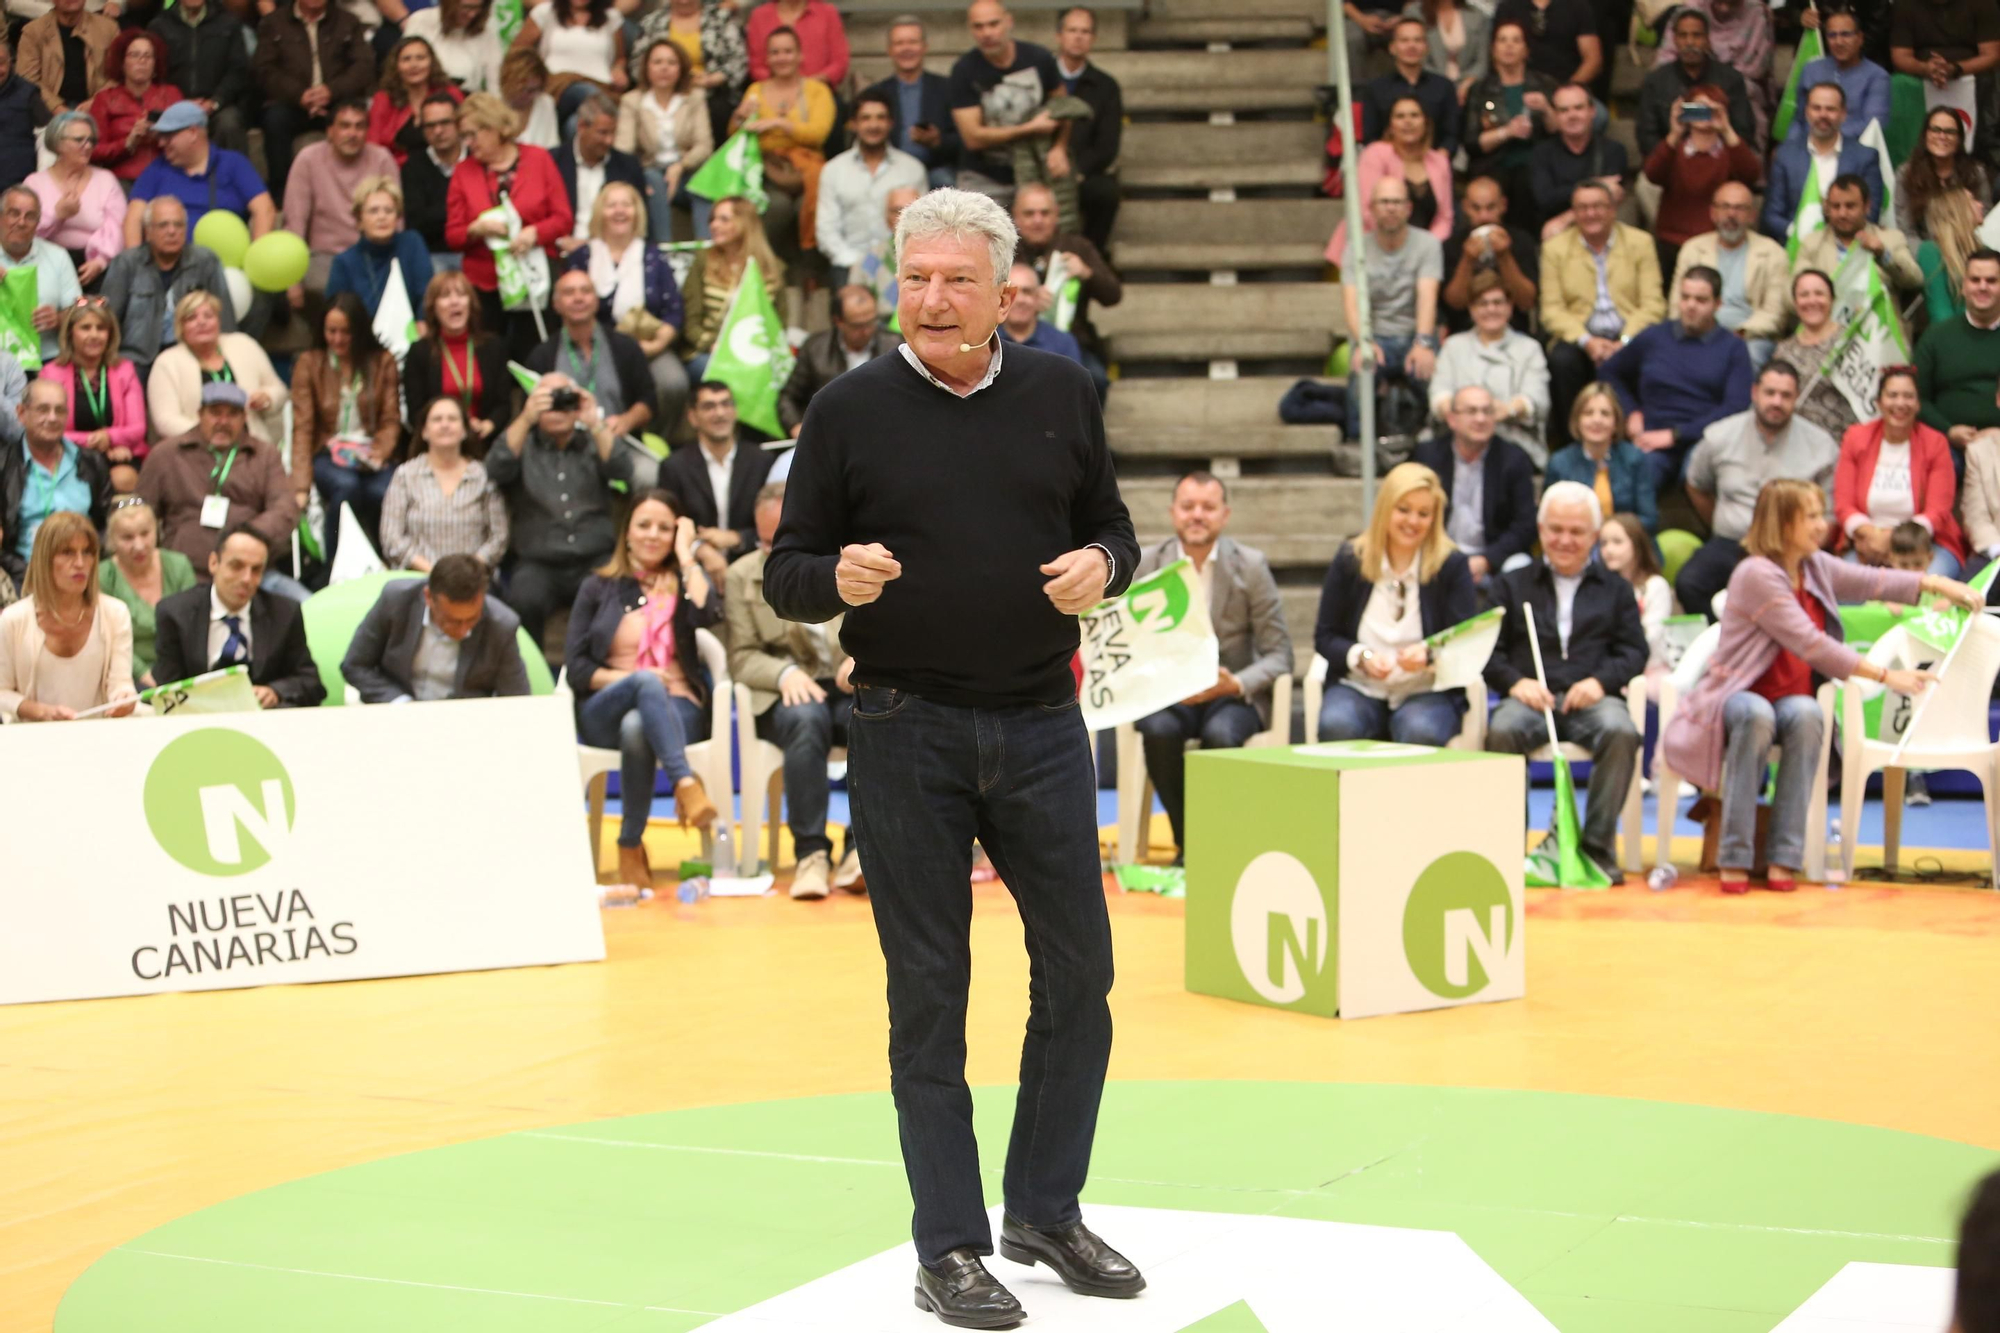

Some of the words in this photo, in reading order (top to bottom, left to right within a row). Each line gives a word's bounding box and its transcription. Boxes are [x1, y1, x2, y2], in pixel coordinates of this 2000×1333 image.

[1102, 609, 1132, 673] EVA
[167, 888, 315, 937] NUEVA
[131, 921, 359, 980] CANARIAS
